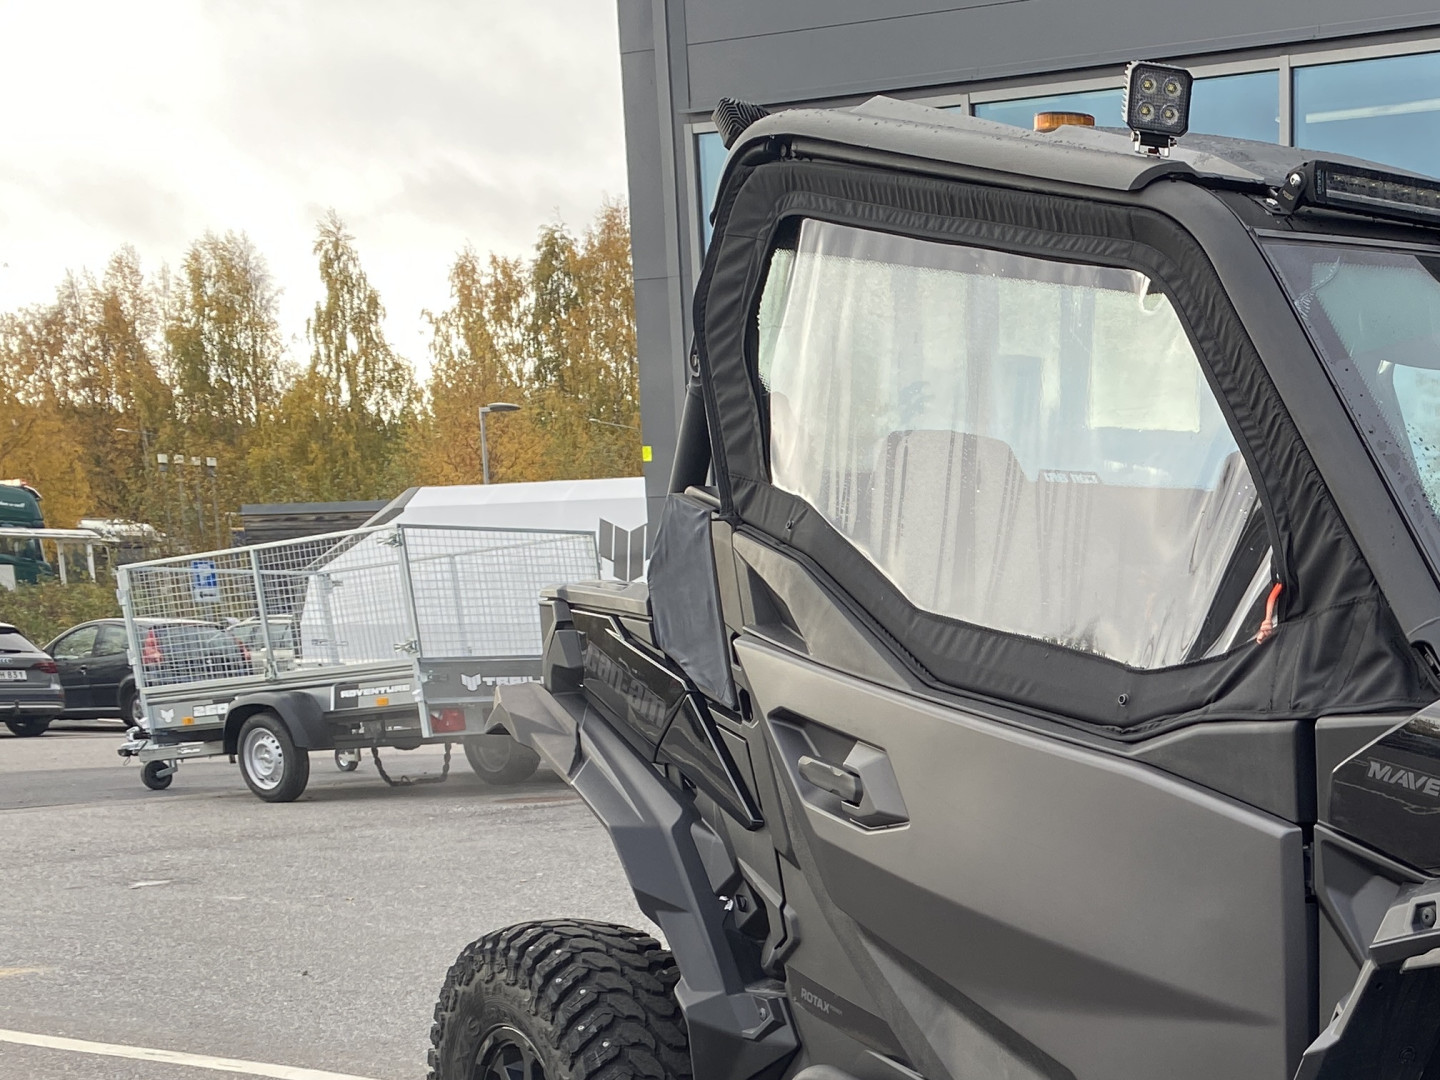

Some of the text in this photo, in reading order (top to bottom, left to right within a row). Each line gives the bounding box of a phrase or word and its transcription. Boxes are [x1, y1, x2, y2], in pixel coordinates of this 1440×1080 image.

[482, 675, 545, 686] TRAIL
[585, 641, 668, 729] can-am
[340, 684, 411, 699] ADVENTURE
[801, 987, 831, 1015] ROTAX
